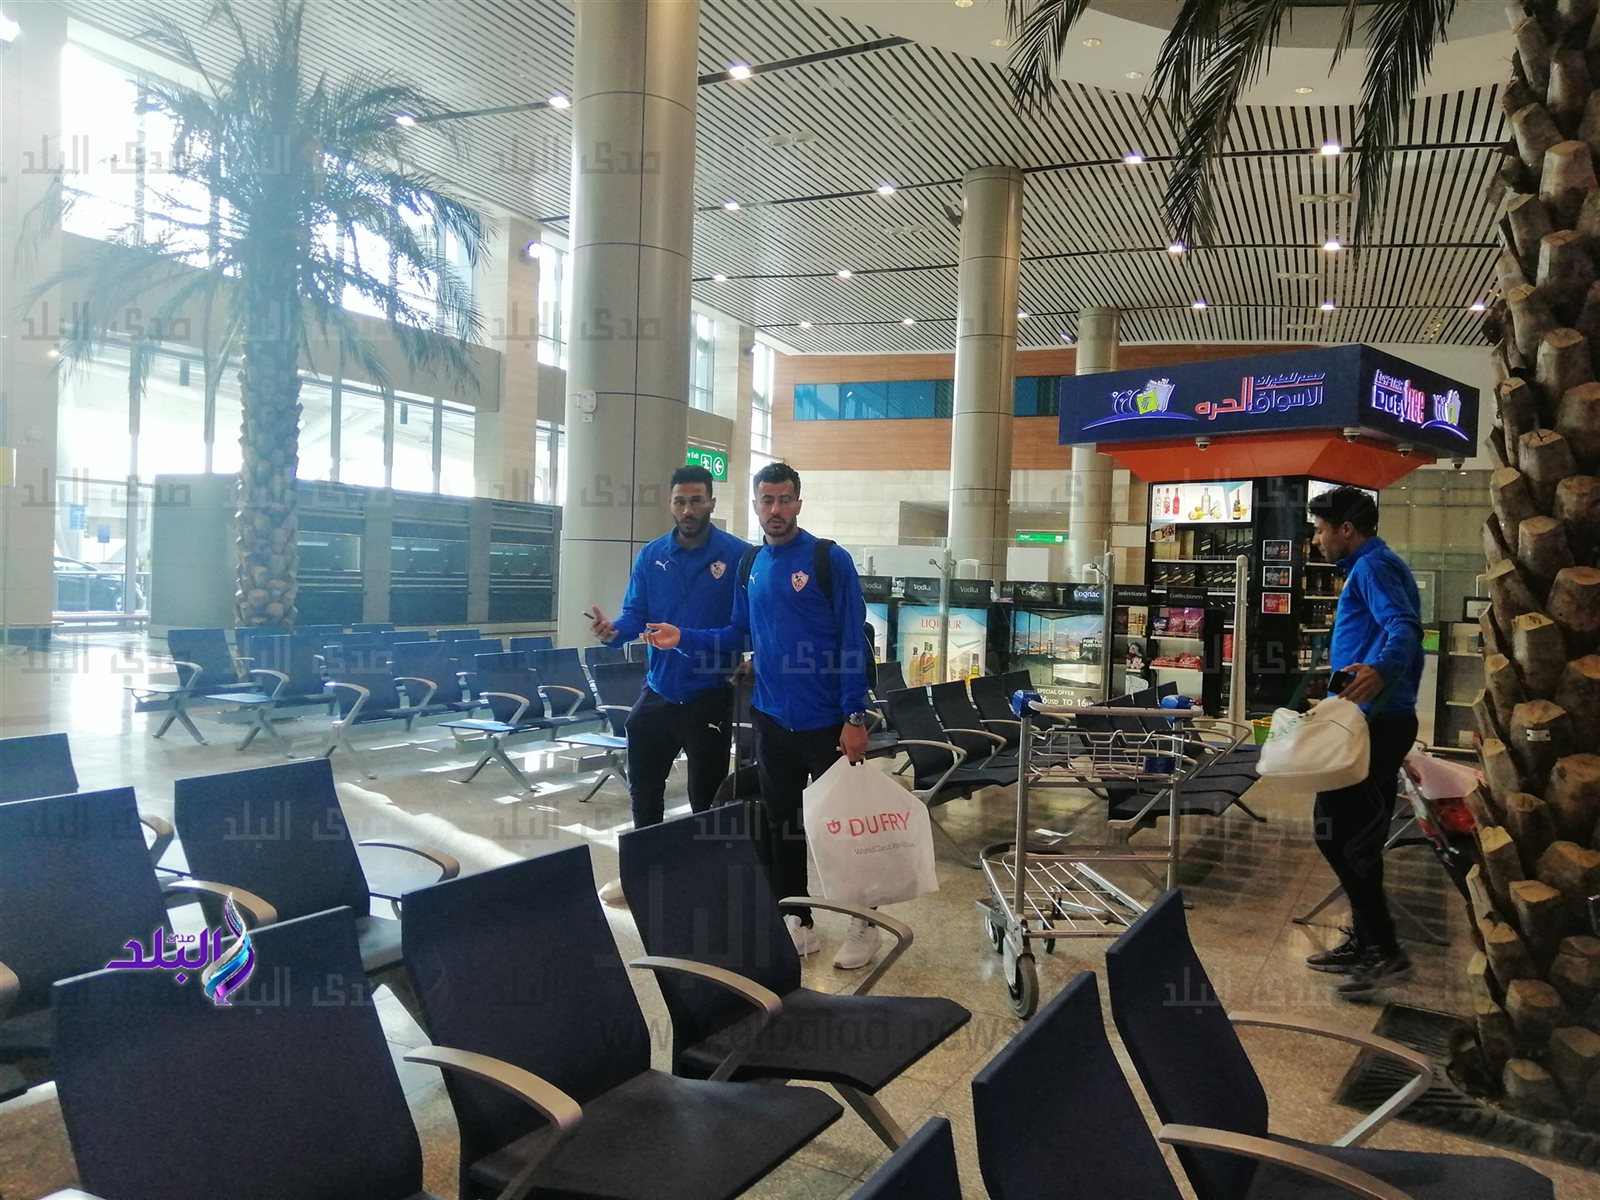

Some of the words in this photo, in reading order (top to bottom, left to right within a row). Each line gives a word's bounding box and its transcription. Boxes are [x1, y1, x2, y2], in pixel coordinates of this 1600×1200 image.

[864, 582, 882, 590] Vodka
[913, 583, 932, 592] Vodka
[960, 586, 979, 594] Vodka
[1073, 589, 1100, 599] Cognac
[921, 618, 961, 630] LIQUR
[1036, 688, 1057, 696] SPECIAL
[1062, 698, 1073, 706] TO
[848, 812, 910, 837] DUFRY
